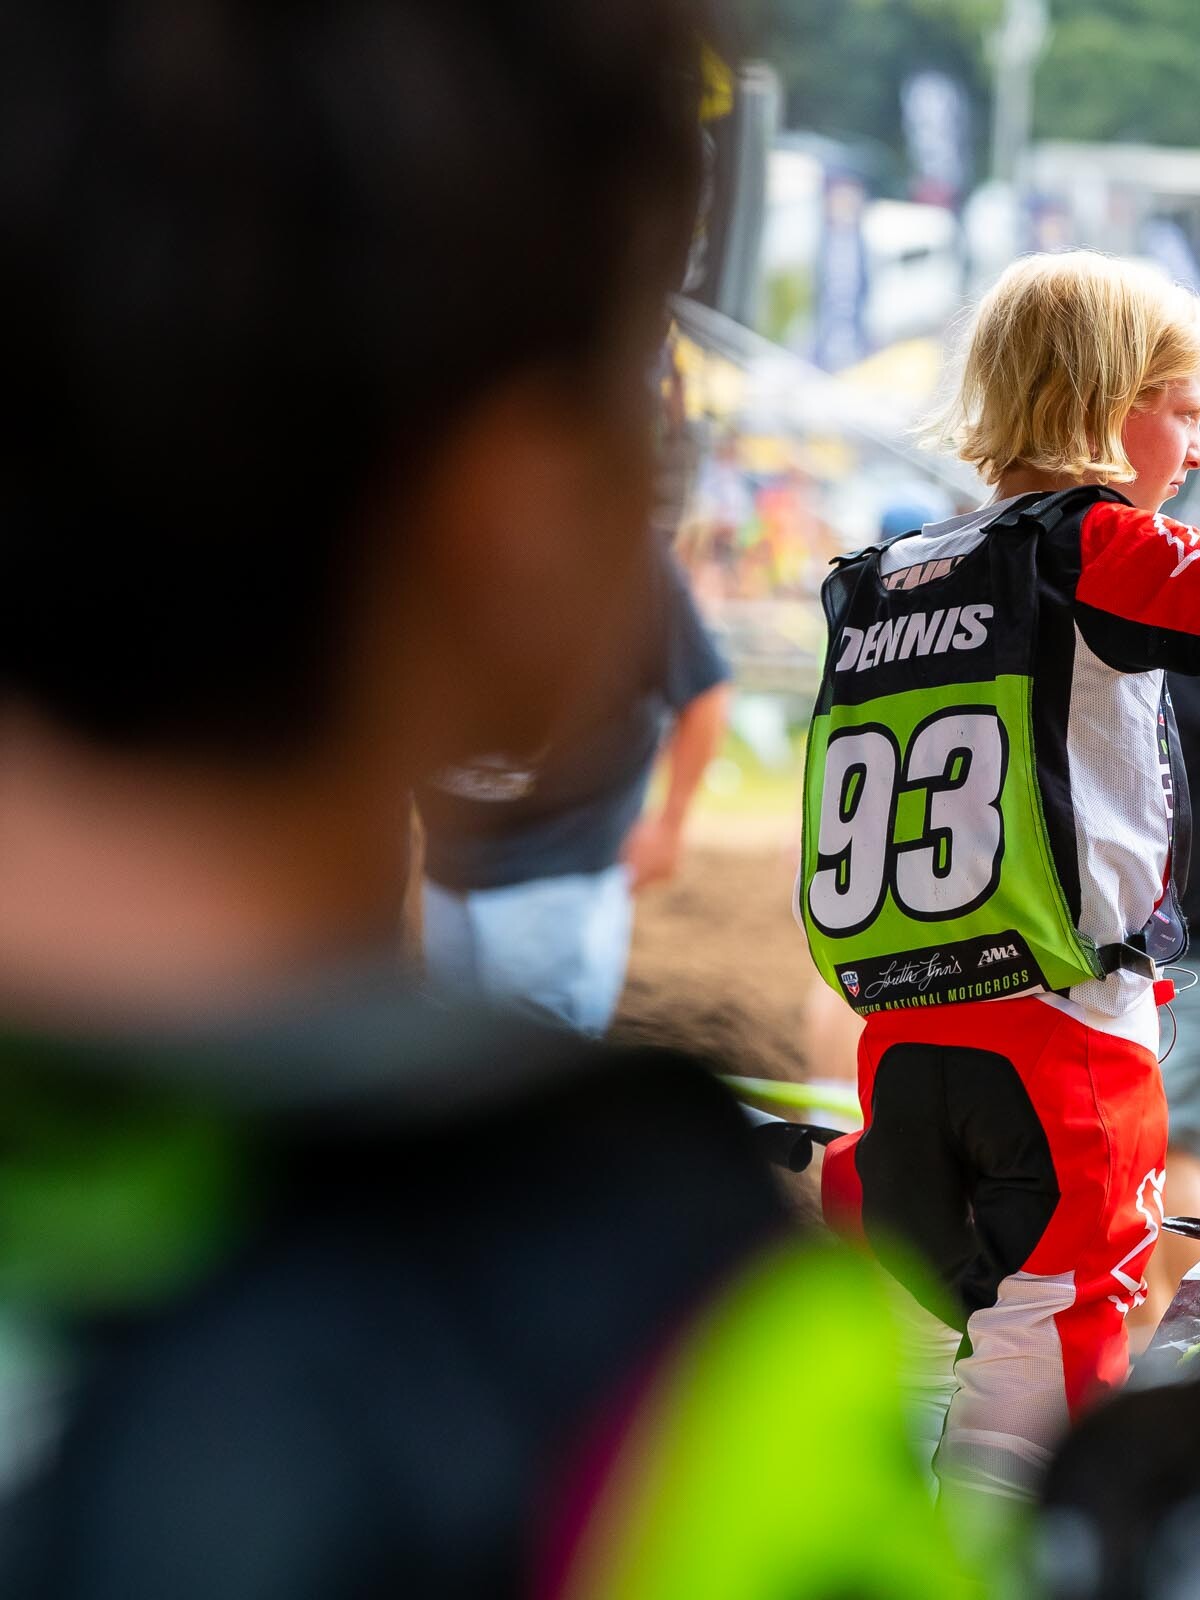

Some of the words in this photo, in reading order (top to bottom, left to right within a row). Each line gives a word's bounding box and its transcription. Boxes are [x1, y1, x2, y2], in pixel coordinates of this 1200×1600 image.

[835, 603, 994, 672] DENNIS
[807, 706, 1006, 936] 93
[977, 944, 1019, 967] AMA
[885, 992, 942, 1010] NATIONAL
[948, 969, 1029, 1002] MOTOCROSS
